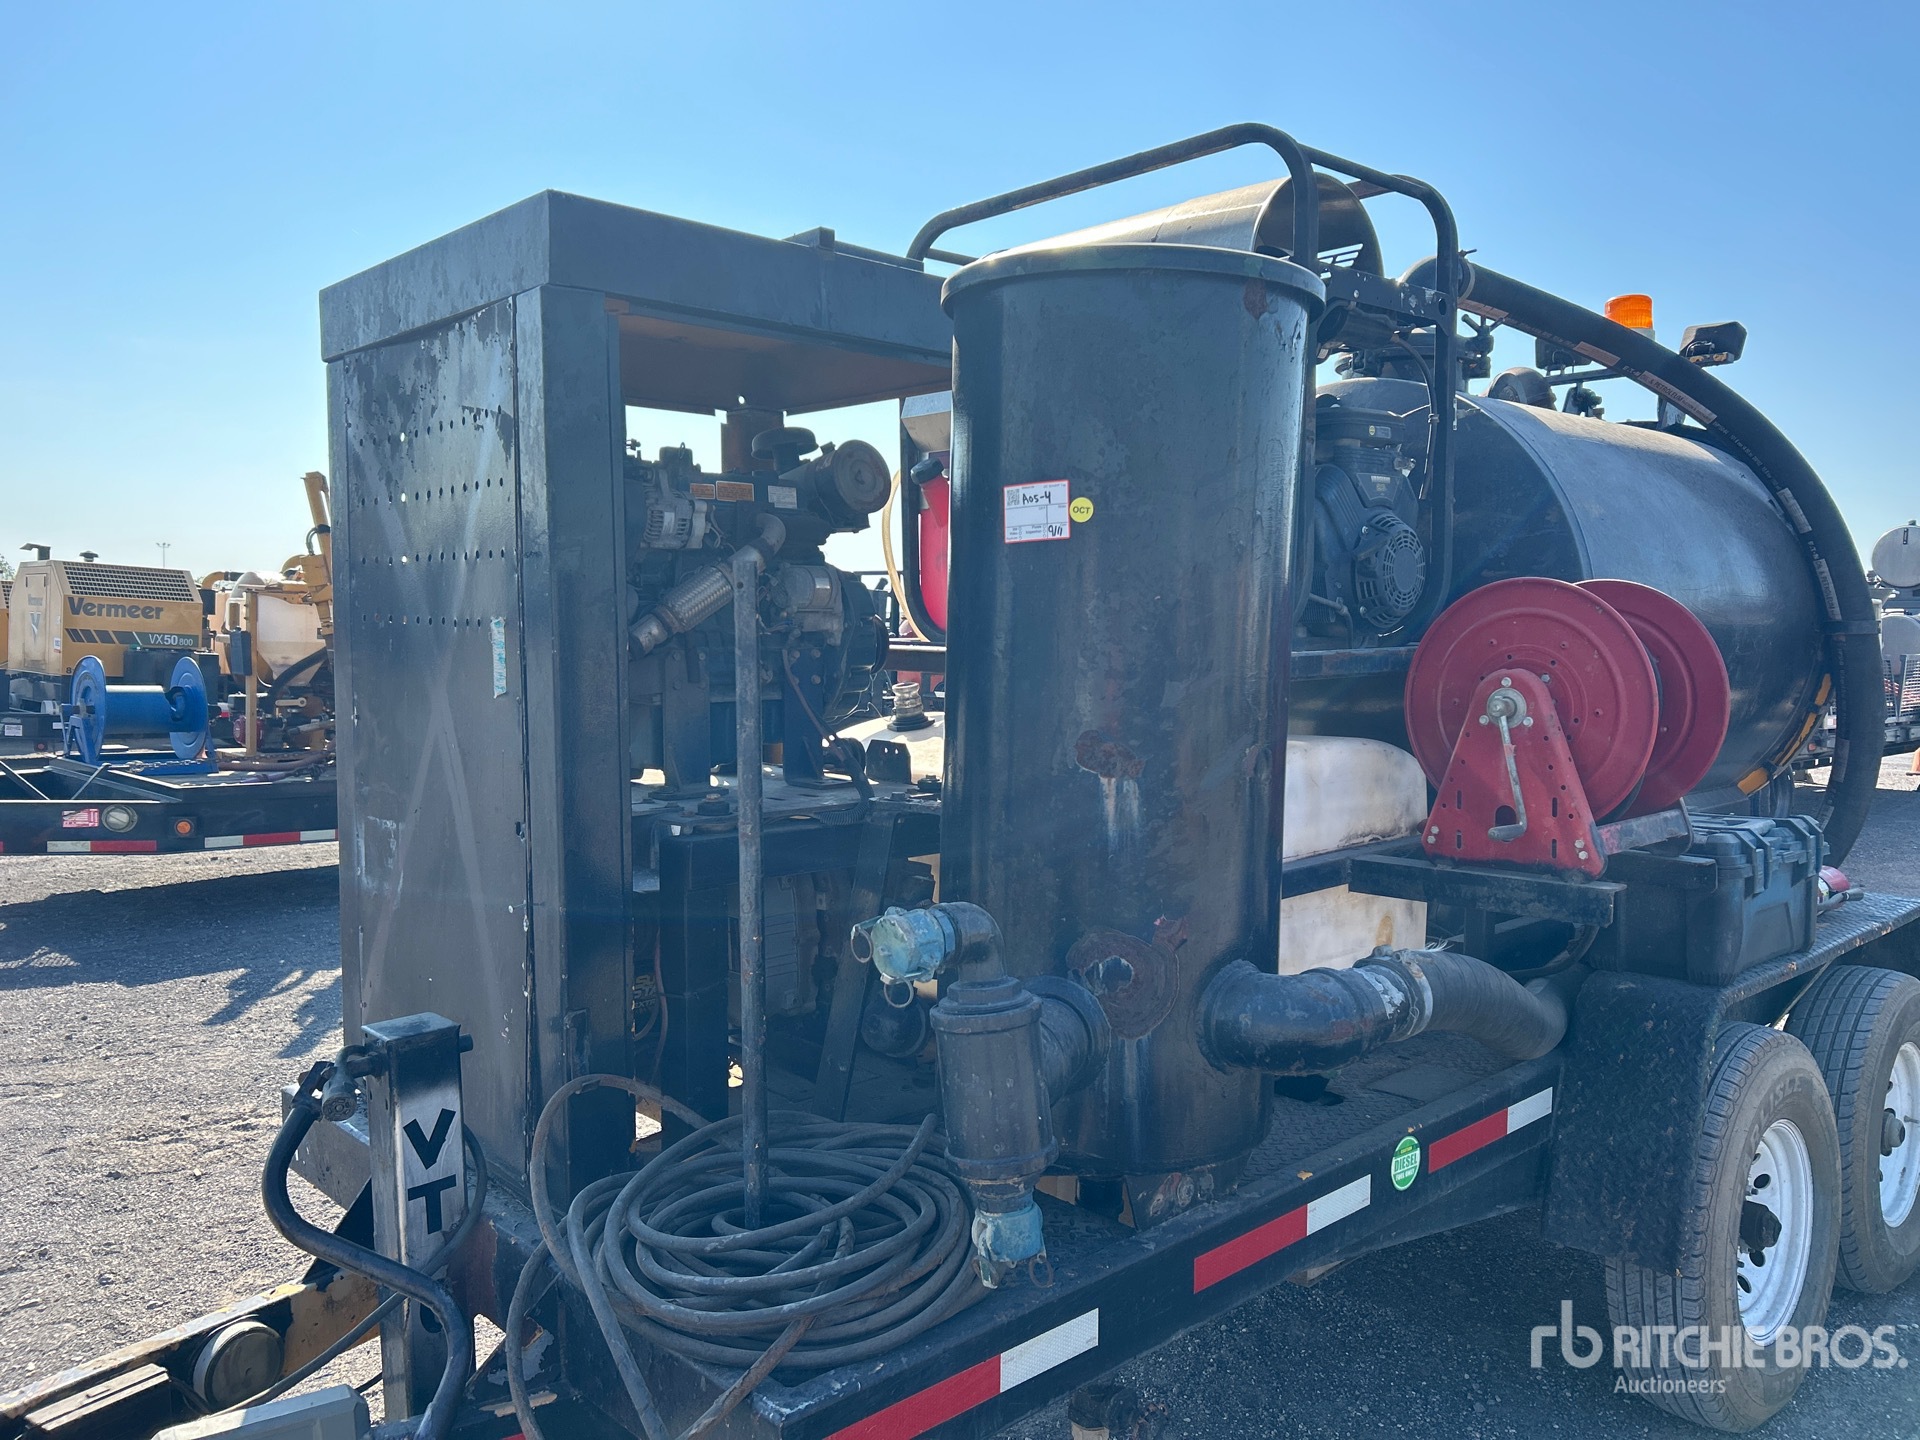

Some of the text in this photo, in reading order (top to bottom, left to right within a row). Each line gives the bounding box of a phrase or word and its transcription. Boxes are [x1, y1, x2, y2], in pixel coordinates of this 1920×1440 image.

[1072, 506, 1090, 514] OCT
[68, 597, 164, 619] Vermeer
[1394, 1152, 1418, 1173] DIESEL
